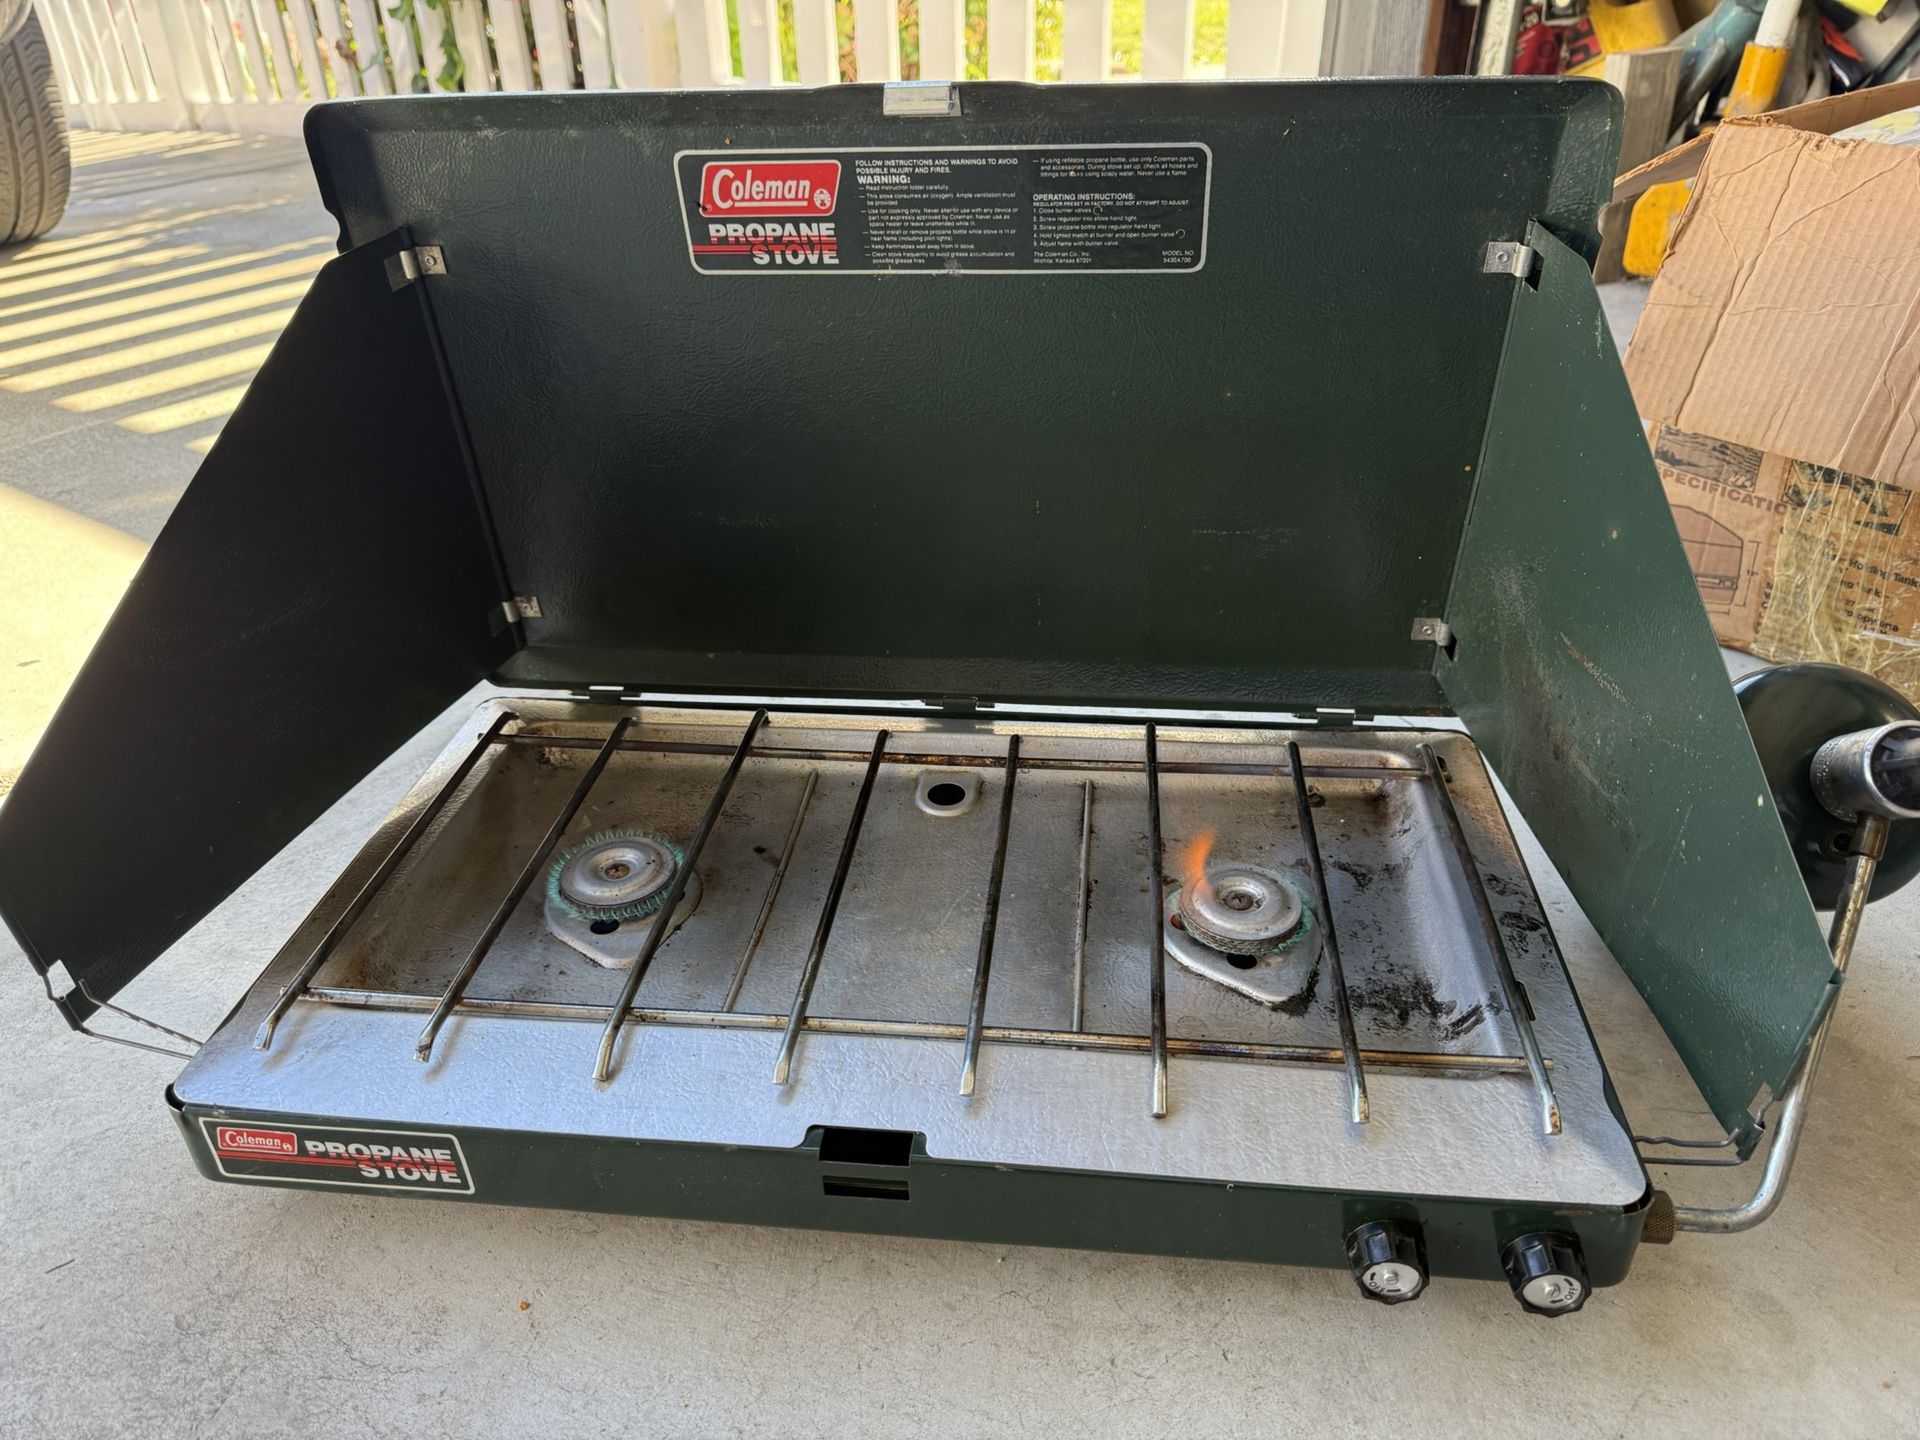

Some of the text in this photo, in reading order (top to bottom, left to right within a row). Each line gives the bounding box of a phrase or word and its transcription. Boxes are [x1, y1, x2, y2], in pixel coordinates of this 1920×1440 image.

[930, 166, 952, 174] FIRES.
[950, 158, 987, 166] WARNINGS
[712, 168, 811, 210] Coleman
[857, 175, 911, 185] WARNING:
[1032, 192, 1136, 201] OPERATING INSTRUCTIONS:
[708, 222, 838, 244] PROPANE
[751, 244, 840, 265] STOVE
[1659, 466, 1789, 516] PECIFICATIO
[1849, 557, 1889, 581] Hoding
[224, 1130, 283, 1149] Coleman
[304, 1140, 456, 1165] PROPANE
[357, 1161, 462, 1184] STOVE
[1369, 1281, 1387, 1293] OFF
[1564, 1286, 1579, 1300] OFF
